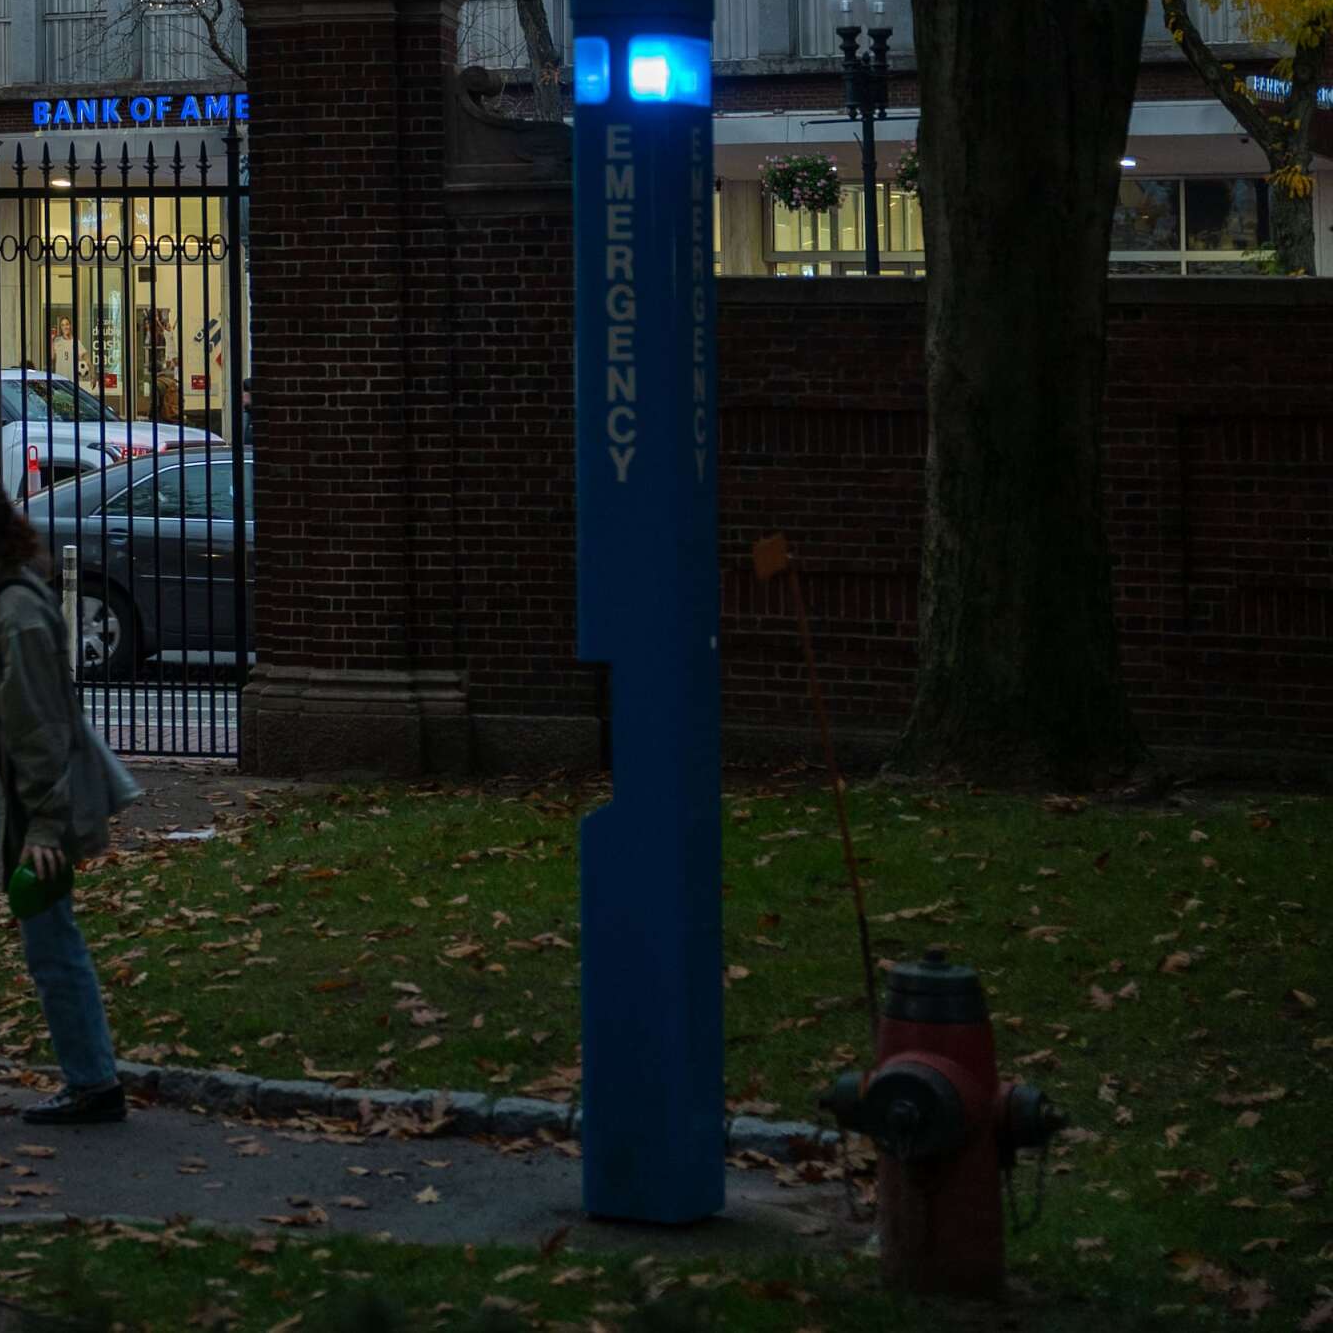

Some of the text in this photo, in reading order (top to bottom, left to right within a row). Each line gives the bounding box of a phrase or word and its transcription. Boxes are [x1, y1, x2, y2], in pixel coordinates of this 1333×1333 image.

[33, 93, 251, 125] BANK OF AME
[605, 124, 636, 483] EMERGENCY
